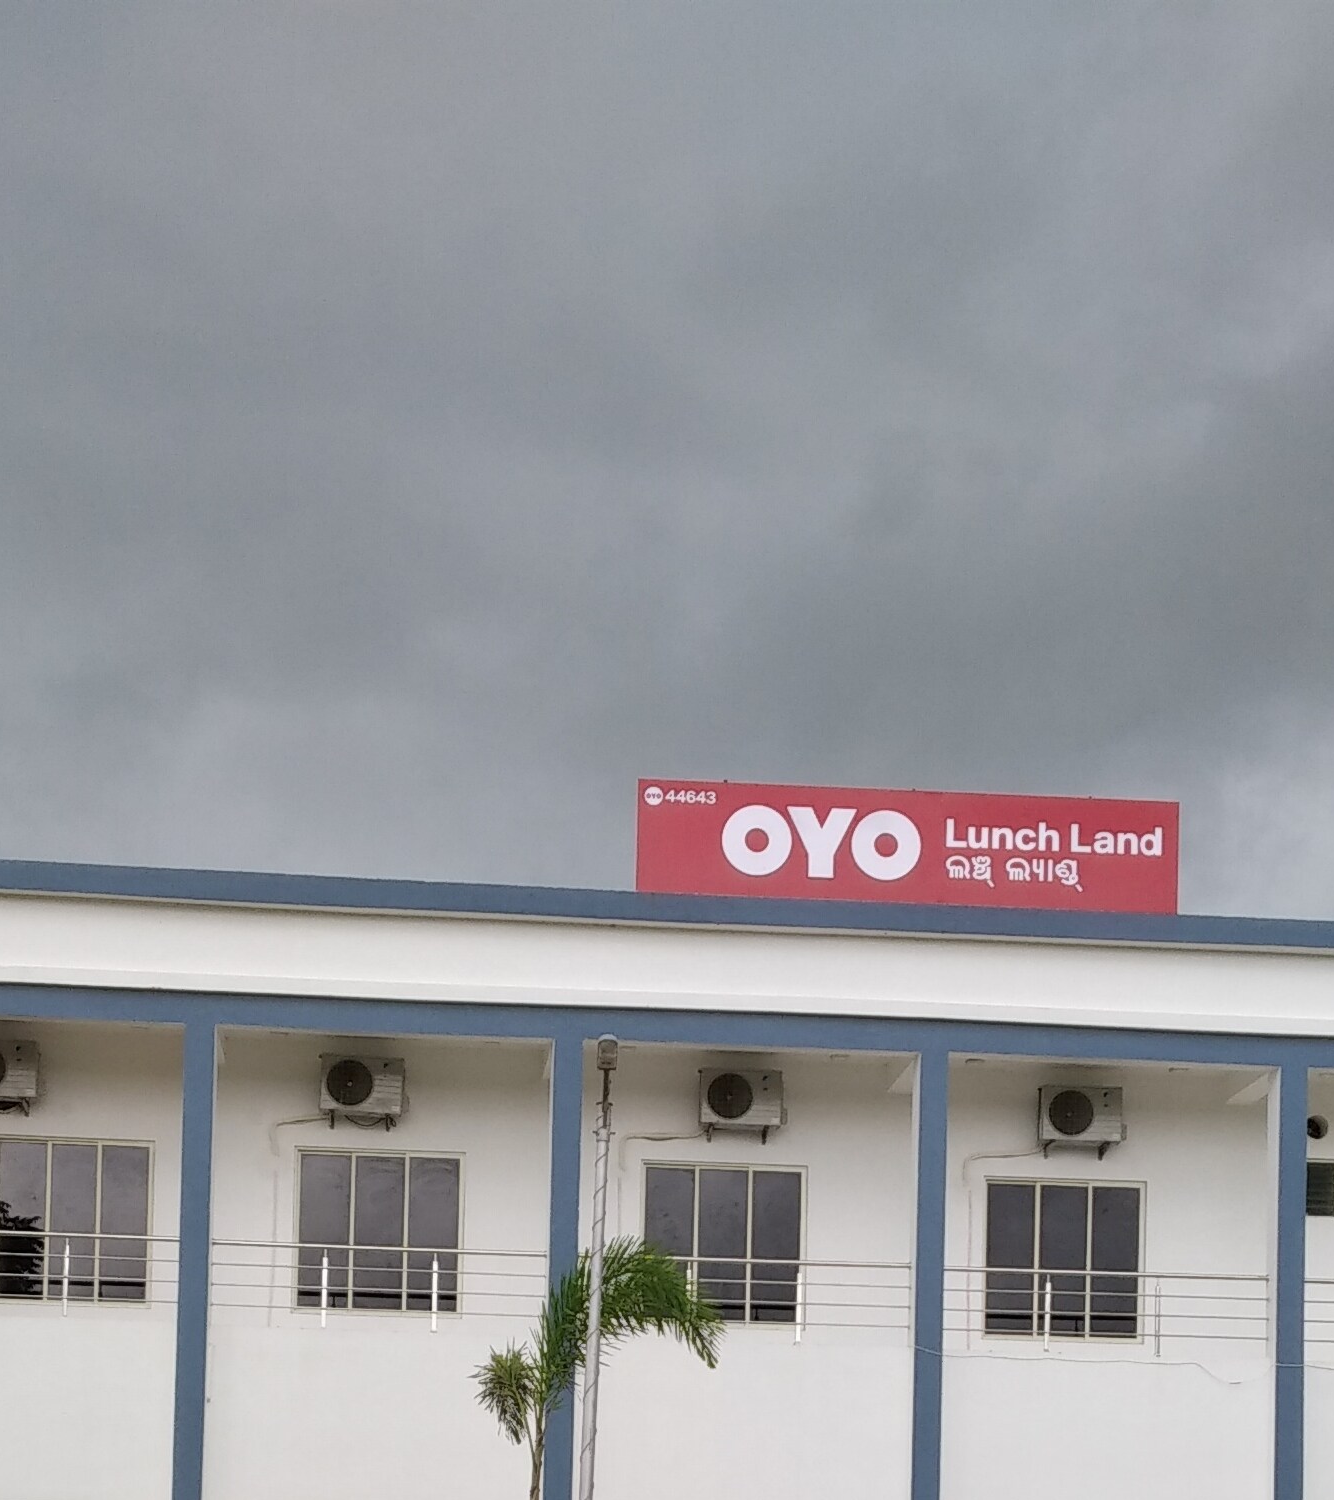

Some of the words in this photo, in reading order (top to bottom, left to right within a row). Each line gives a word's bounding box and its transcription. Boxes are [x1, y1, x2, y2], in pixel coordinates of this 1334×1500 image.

[664, 788, 717, 805] 44643
[721, 804, 922, 881] OYO
[944, 818, 1061, 853] Lunch
[1069, 823, 1163, 857] Land
